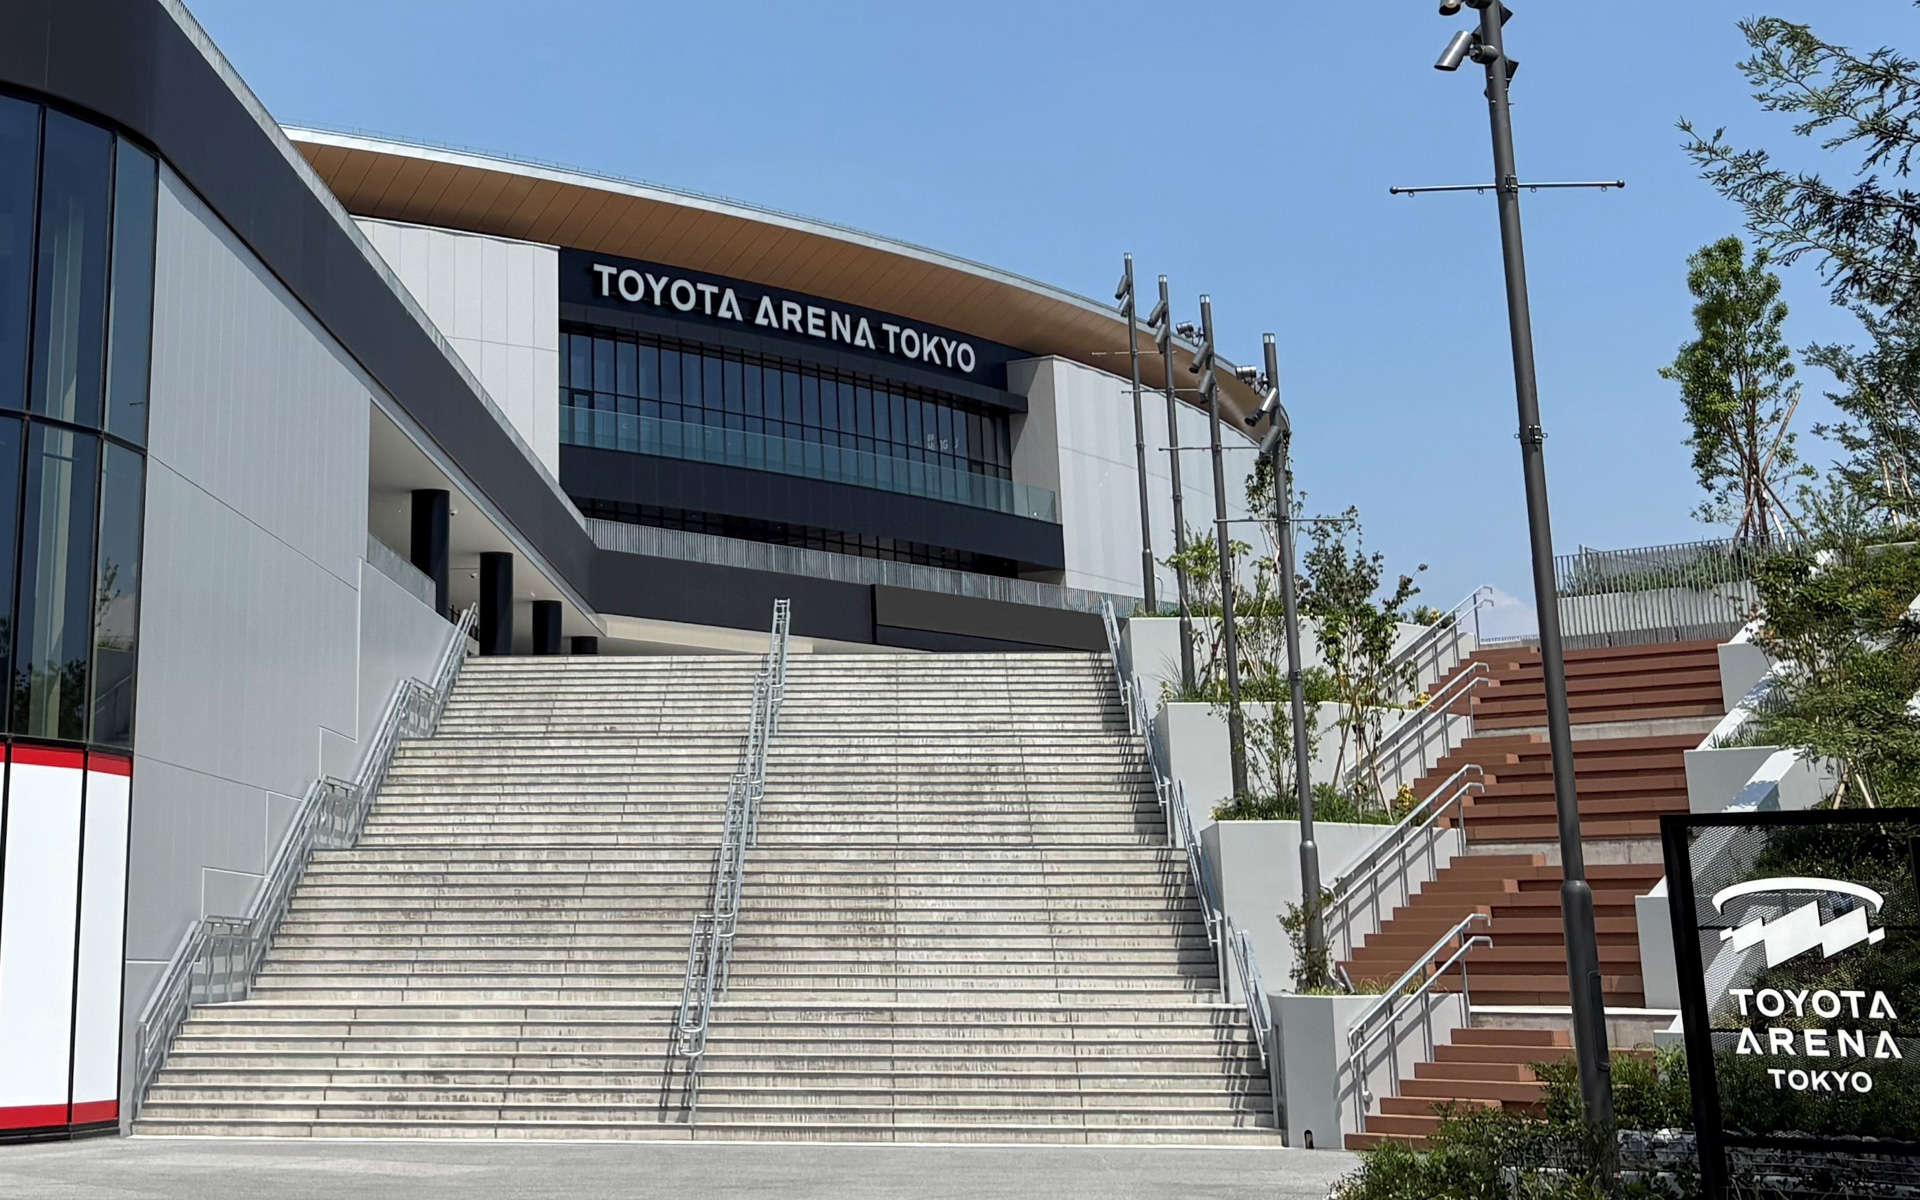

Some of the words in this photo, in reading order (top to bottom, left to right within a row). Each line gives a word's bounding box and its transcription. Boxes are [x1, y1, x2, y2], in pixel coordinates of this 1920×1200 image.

[593, 263, 743, 321] TOYOTA
[755, 295, 876, 350] ARENA
[881, 322, 976, 373] TOKYO
[1728, 988, 1898, 1019] TOYOTA
[1735, 1027, 1903, 1059] ARENA
[1767, 1068, 1873, 1093] TOKYO
